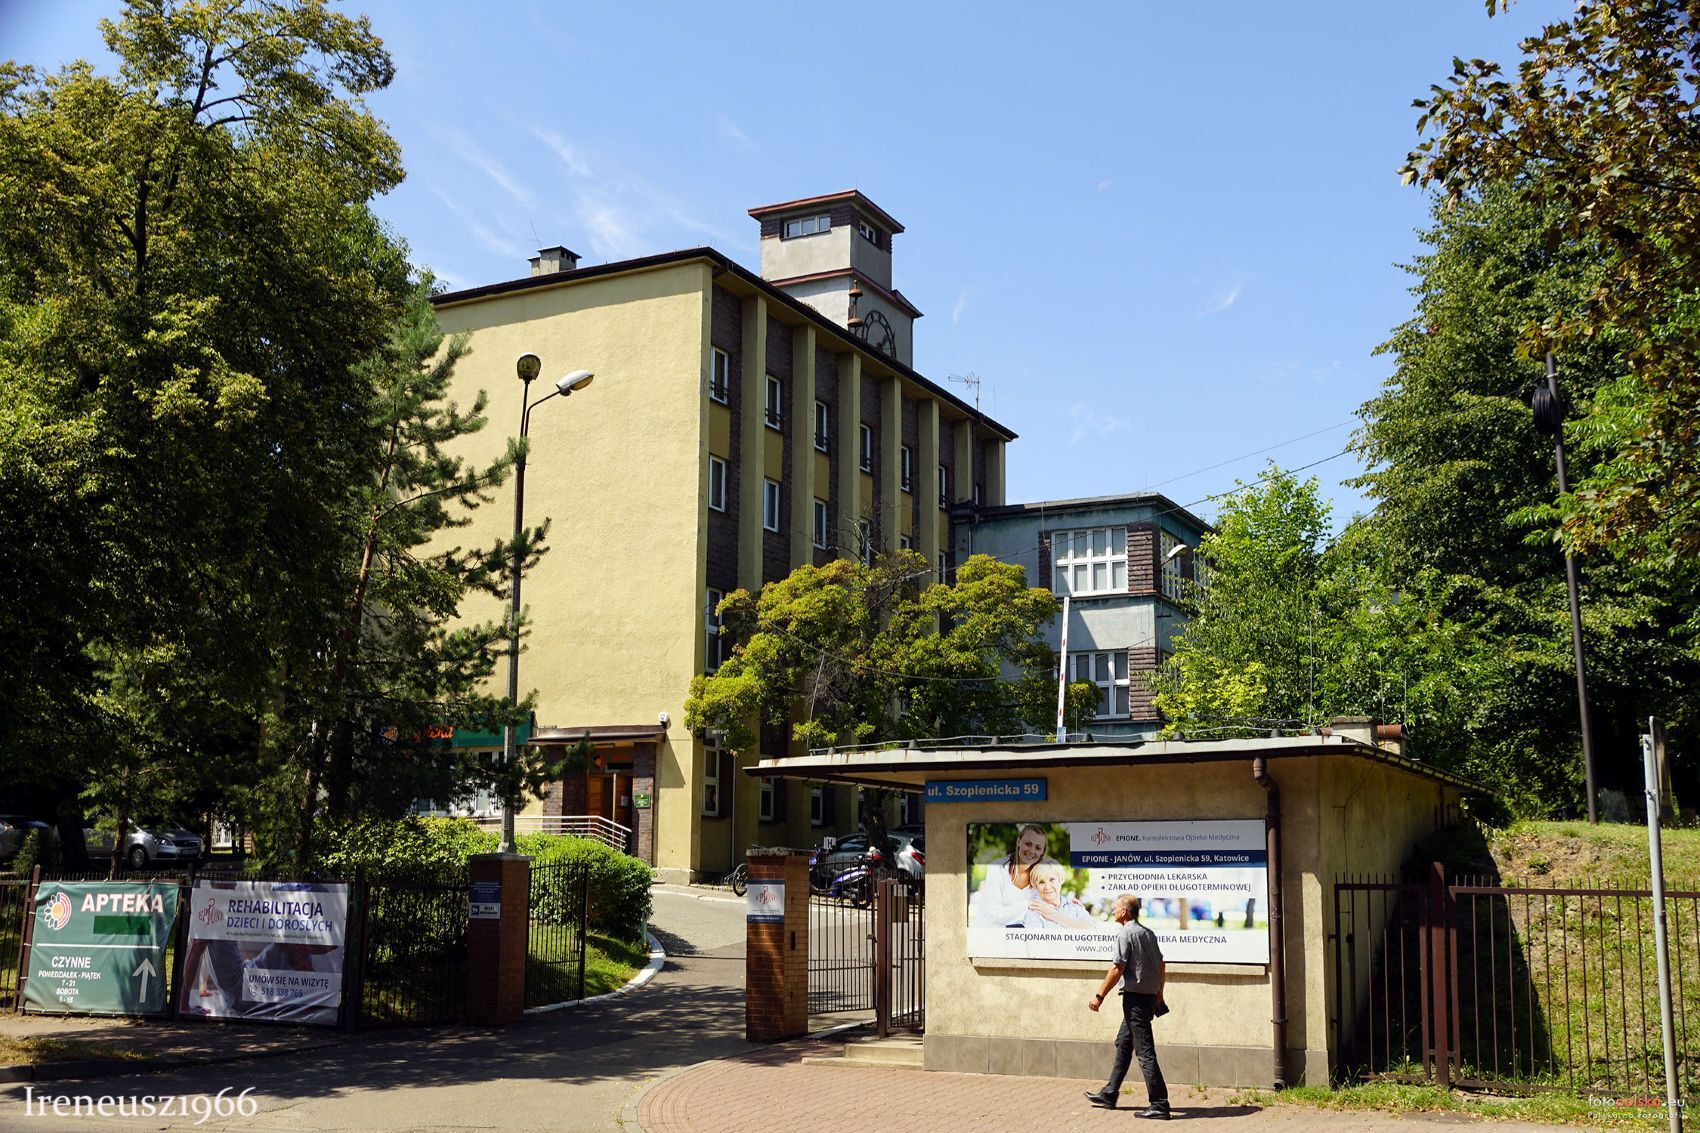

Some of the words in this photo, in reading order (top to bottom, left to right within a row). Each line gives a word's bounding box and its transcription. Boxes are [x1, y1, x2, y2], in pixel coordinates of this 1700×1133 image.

[927, 786, 942, 796] ul.
[946, 784, 1020, 798] Szopienicka
[1024, 784, 1039, 794] 59
[1142, 834, 1185, 843] Kompleksowa
[1186, 834, 1208, 842] Opieka
[1208, 834, 1240, 842] Medyczna
[1114, 854, 1143, 864] JANÓW,
[1144, 854, 1154, 862] ul.
[1156, 854, 1200, 864] Szopienicka
[1200, 855, 1212, 864] 59,
[1170, 884, 1251, 892] DŁUGOTERMINOWEJ
[80, 893, 164, 912] APTEKA
[228, 900, 324, 919] REHABILITACJA
[227, 916, 260, 929] DZIECI
[262, 918, 266, 930] I
[268, 918, 333, 932] DOROSŁYCH
[1005, 933, 1062, 942] STACJONARNA
[1180, 936, 1227, 944] MEDYCZNA
[51, 956, 92, 968] CZYNNE
[38, 970, 78, 978] PONIEDZIAŁEK
[81, 972, 102, 980] PIĄTEK
[248, 974, 274, 984] UMÓW
[276, 976, 286, 987] SIĘ
[288, 978, 300, 986] NA
[301, 978, 328, 990] WIZYTĘ
